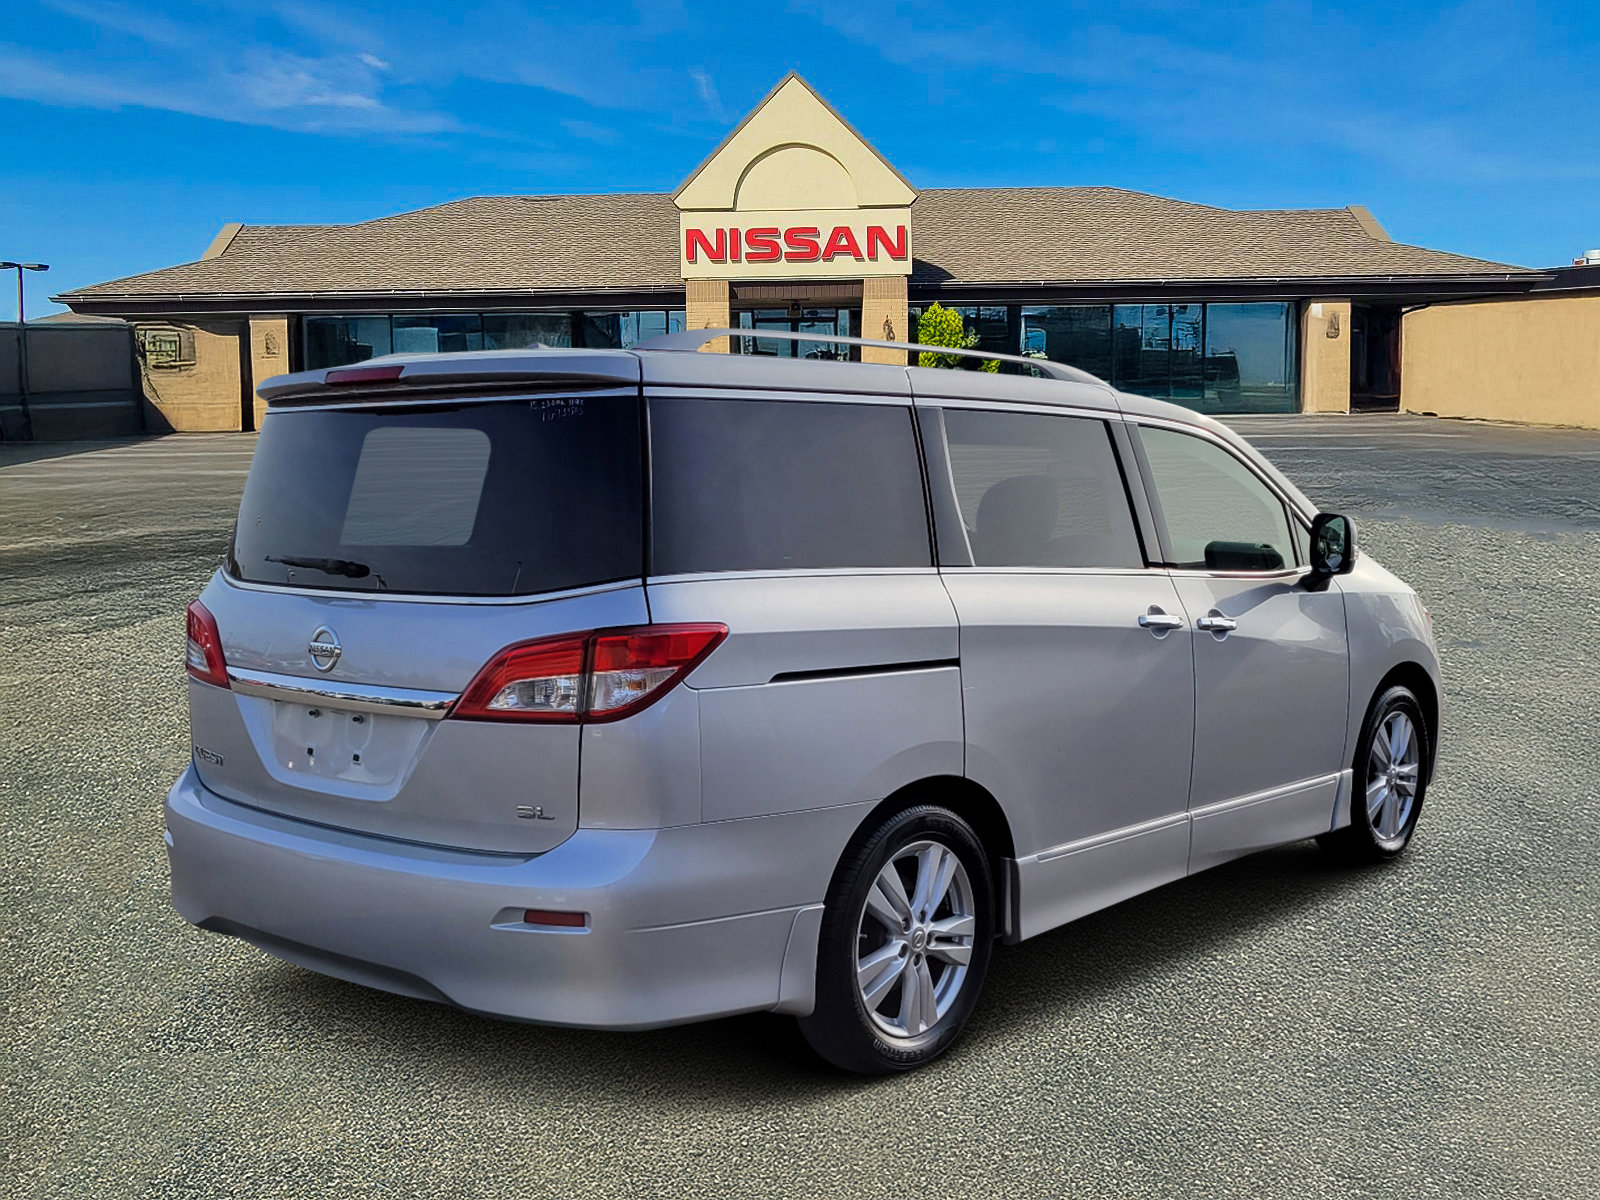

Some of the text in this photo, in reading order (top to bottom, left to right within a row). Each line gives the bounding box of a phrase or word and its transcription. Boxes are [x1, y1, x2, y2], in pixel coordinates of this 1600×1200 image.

[685, 225, 908, 264] NISSAN
[310, 644, 340, 656] NISSAN
[516, 805, 556, 820] SL
